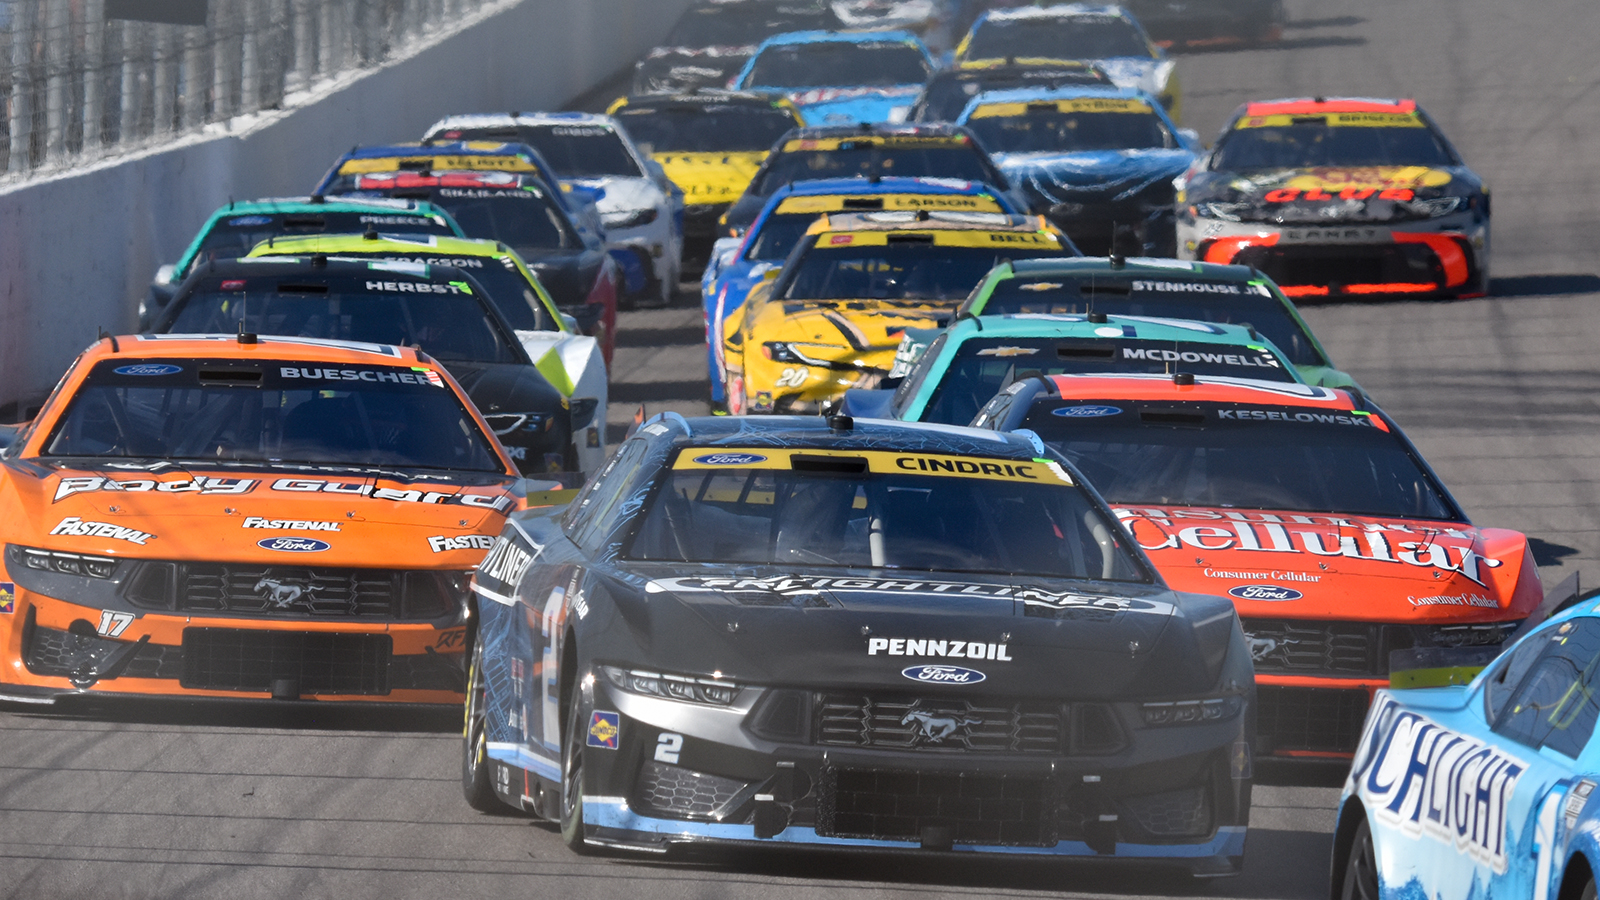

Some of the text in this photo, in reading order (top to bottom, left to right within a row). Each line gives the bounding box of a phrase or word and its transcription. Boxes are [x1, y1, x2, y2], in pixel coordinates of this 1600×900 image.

[895, 198, 977, 208] LARSON
[990, 233, 1046, 245] BELL
[365, 280, 460, 295] HERBST
[1131, 280, 1240, 295] STENHOUSE
[1123, 348, 1273, 368] MCDOWELL
[279, 366, 436, 386] BUESCHER
[774, 365, 809, 388] 20
[1217, 408, 1377, 428] KESELOWSKI
[895, 456, 1038, 480] CINDRIC
[53, 475, 514, 514] Body Guard
[49, 516, 155, 546] FASTENAL
[242, 516, 343, 532] FASTENAL
[427, 534, 500, 553] FASTEN
[1118, 516, 1502, 588] Cellular
[1203, 567, 1322, 583] Consumer Cellular
[1239, 585, 1290, 601] Ford
[1407, 592, 1499, 609] Consumer Cellular
[97, 609, 135, 639] 17
[436, 630, 466, 649] RF
[867, 637, 1012, 662] PENNZOIL
[914, 665, 972, 684] Ford
[653, 732, 684, 764] 2
